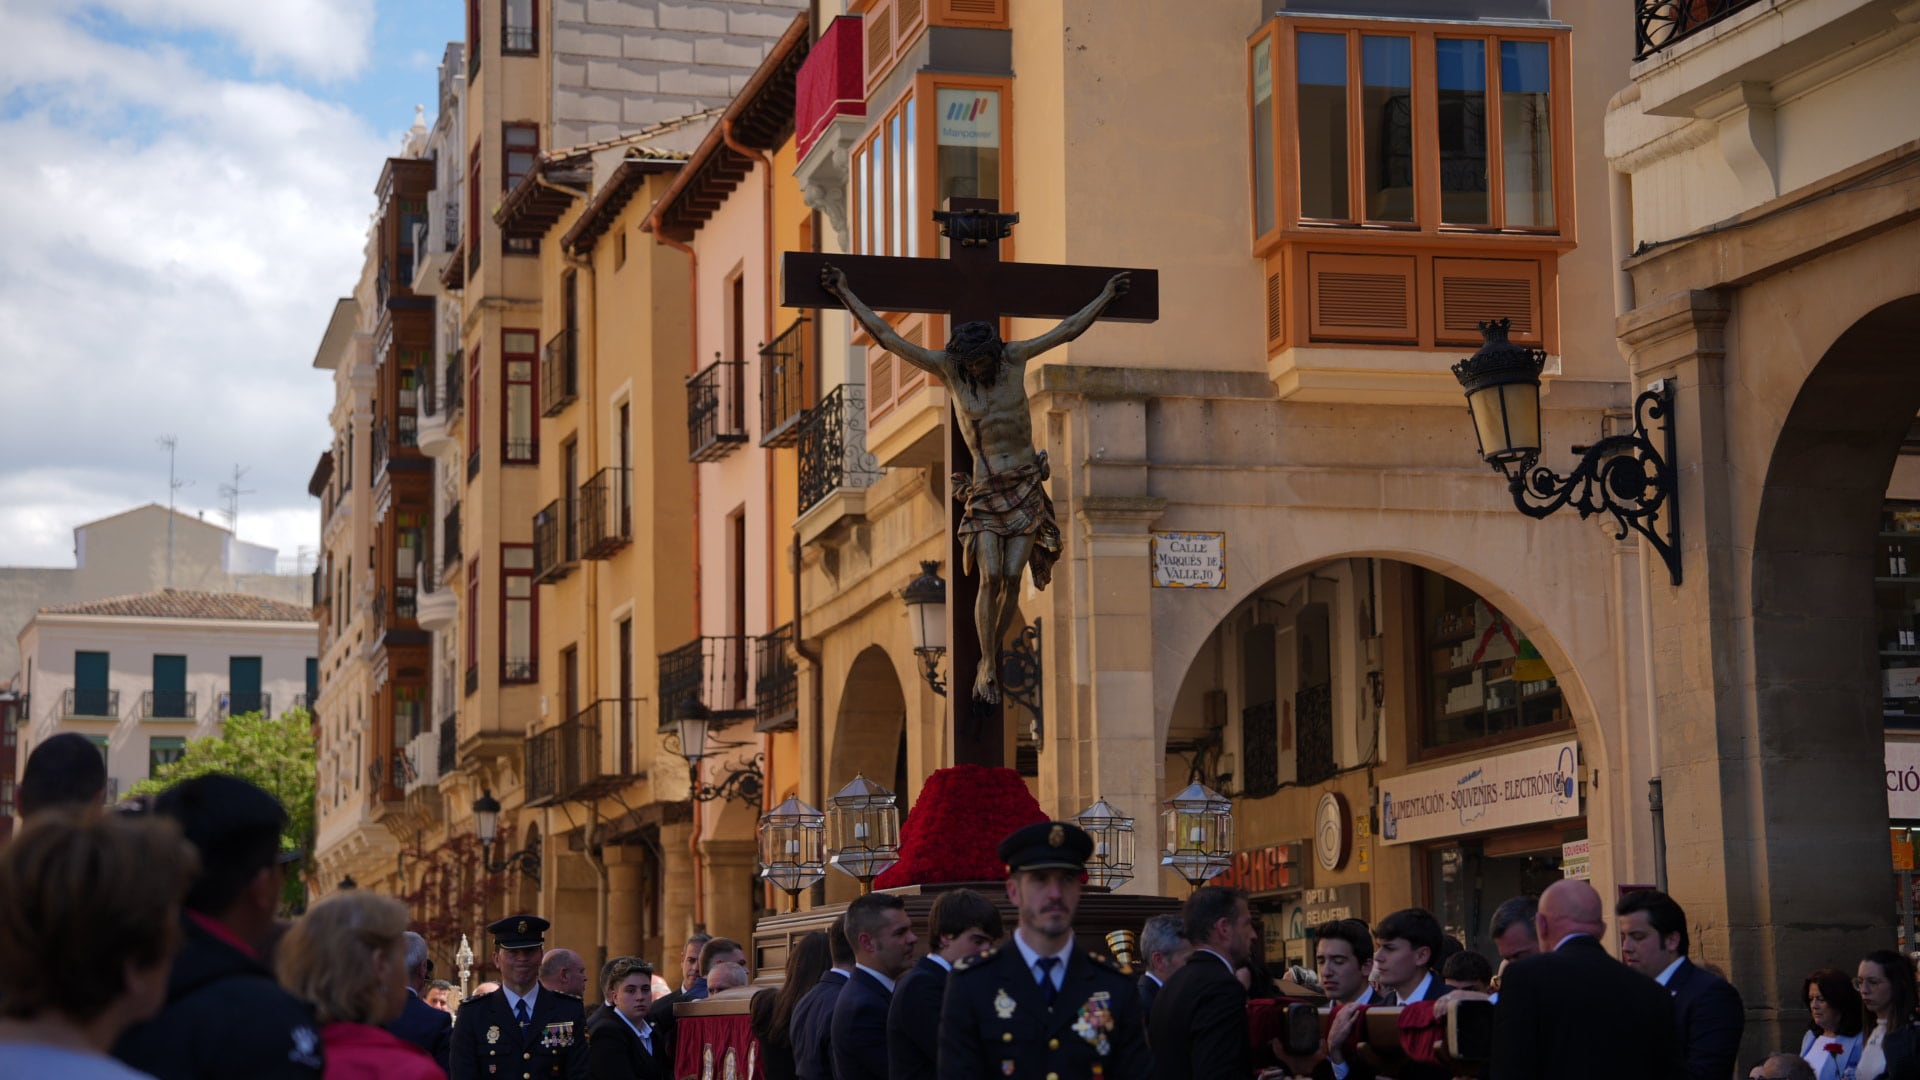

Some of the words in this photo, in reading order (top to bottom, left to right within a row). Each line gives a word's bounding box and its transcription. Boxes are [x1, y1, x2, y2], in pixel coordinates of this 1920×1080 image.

[942, 127, 993, 139] Manpower
[1170, 541, 1208, 553] CALLE
[1207, 556, 1218, 567] DE
[1164, 566, 1214, 580] VALLEJO
[1451, 783, 1498, 811] SOUVENIRS
[1504, 770, 1566, 801] ELECTRÓNICA
